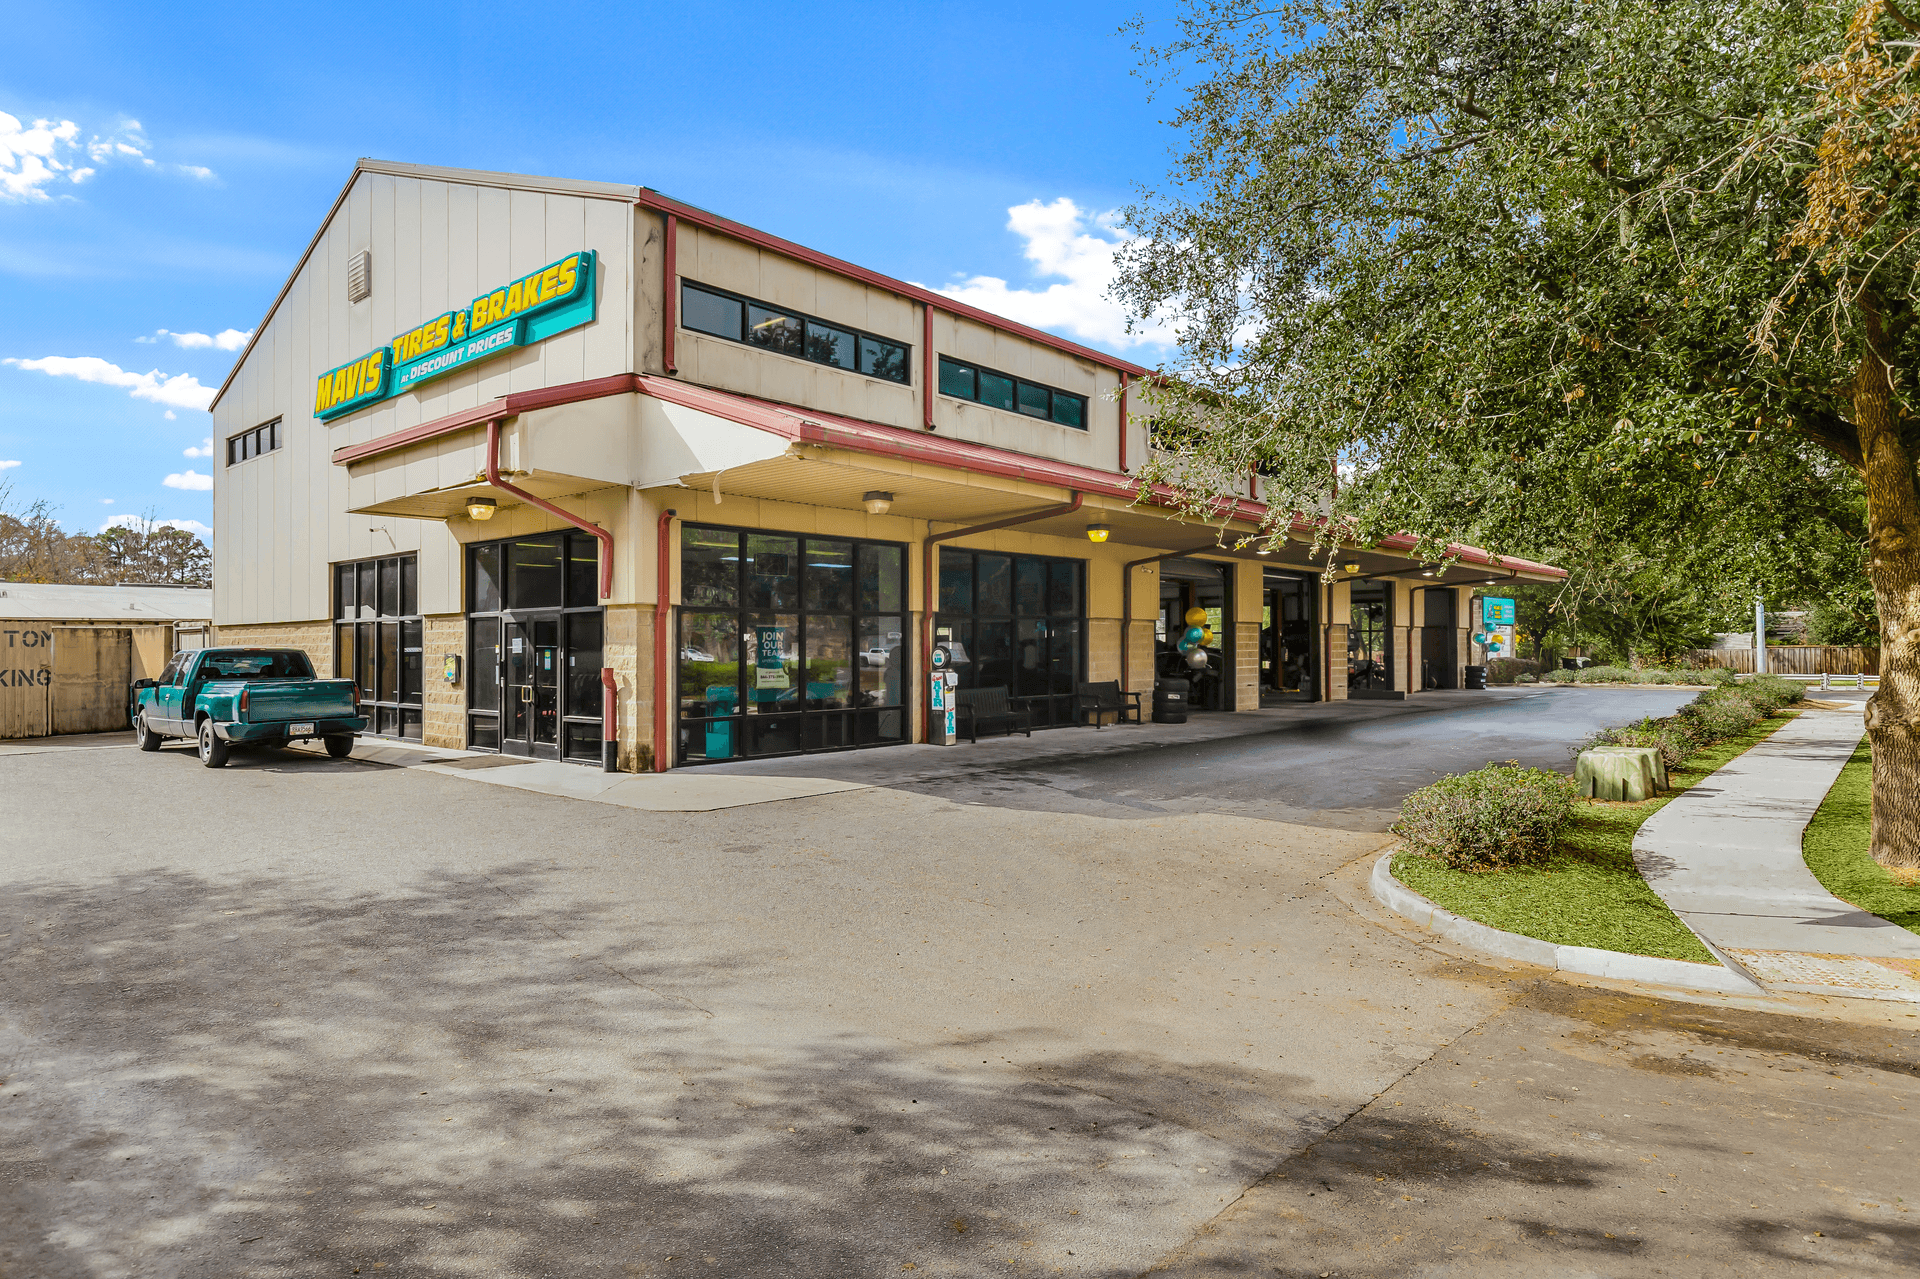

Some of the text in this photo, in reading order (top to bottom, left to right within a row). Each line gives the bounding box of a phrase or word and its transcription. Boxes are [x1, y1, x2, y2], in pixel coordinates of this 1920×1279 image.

[315, 255, 579, 414] MAVIS TIRES & BRAKES
[410, 347, 465, 380] DISCOUNT
[467, 327, 513, 357] PRICES
[762, 632, 784, 643] JOIN
[933, 681, 942, 707] AIR
